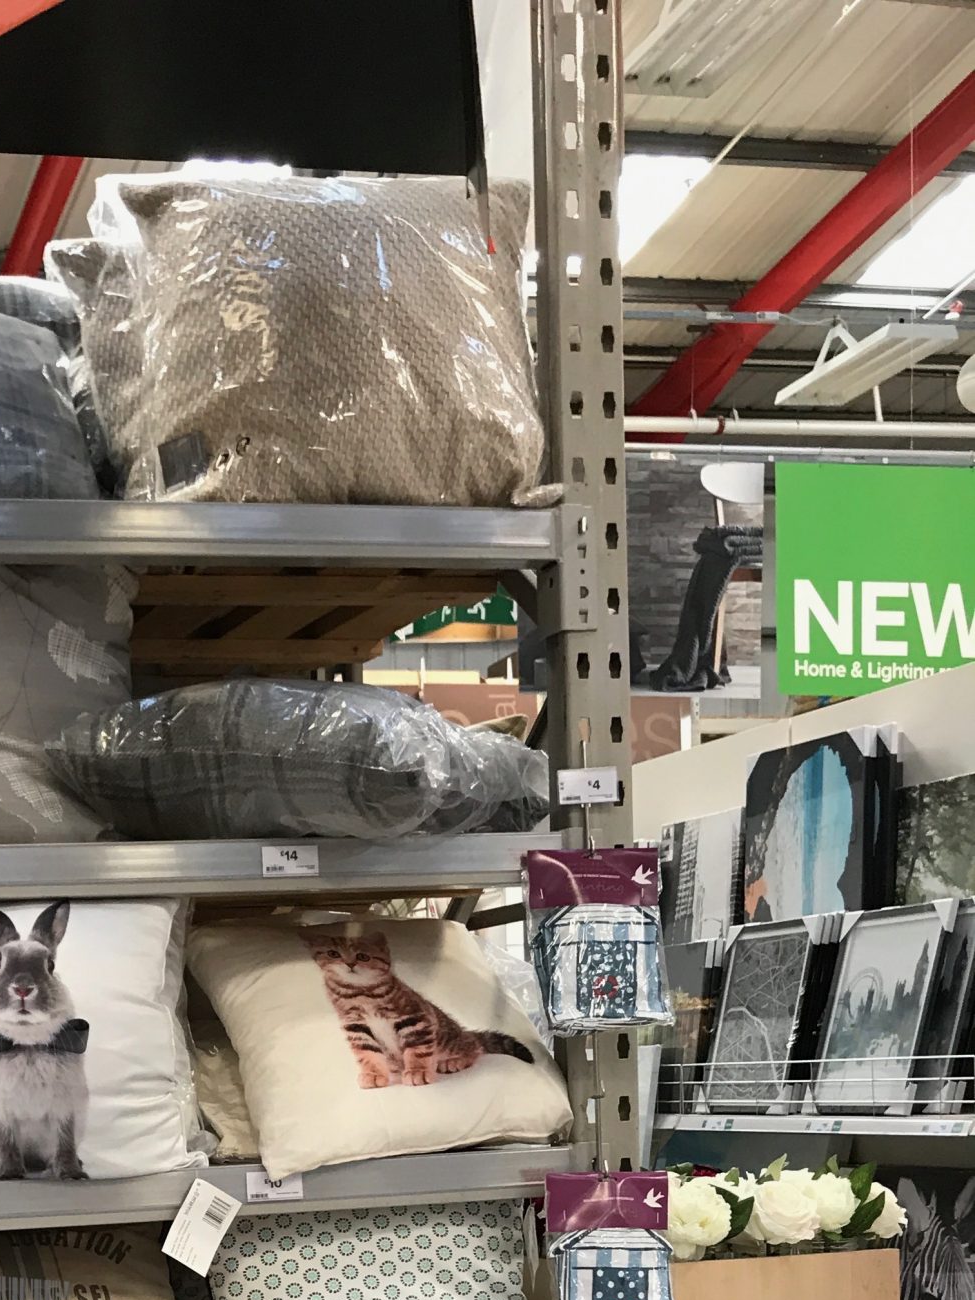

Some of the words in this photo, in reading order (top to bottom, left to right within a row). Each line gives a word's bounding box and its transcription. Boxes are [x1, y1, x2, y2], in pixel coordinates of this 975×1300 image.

[794, 579, 975, 658] NEW
[794, 660, 846, 677] Home
[851, 661, 863, 678] &
[588, 780, 601, 790] £4
[280, 850, 298, 861] £14
